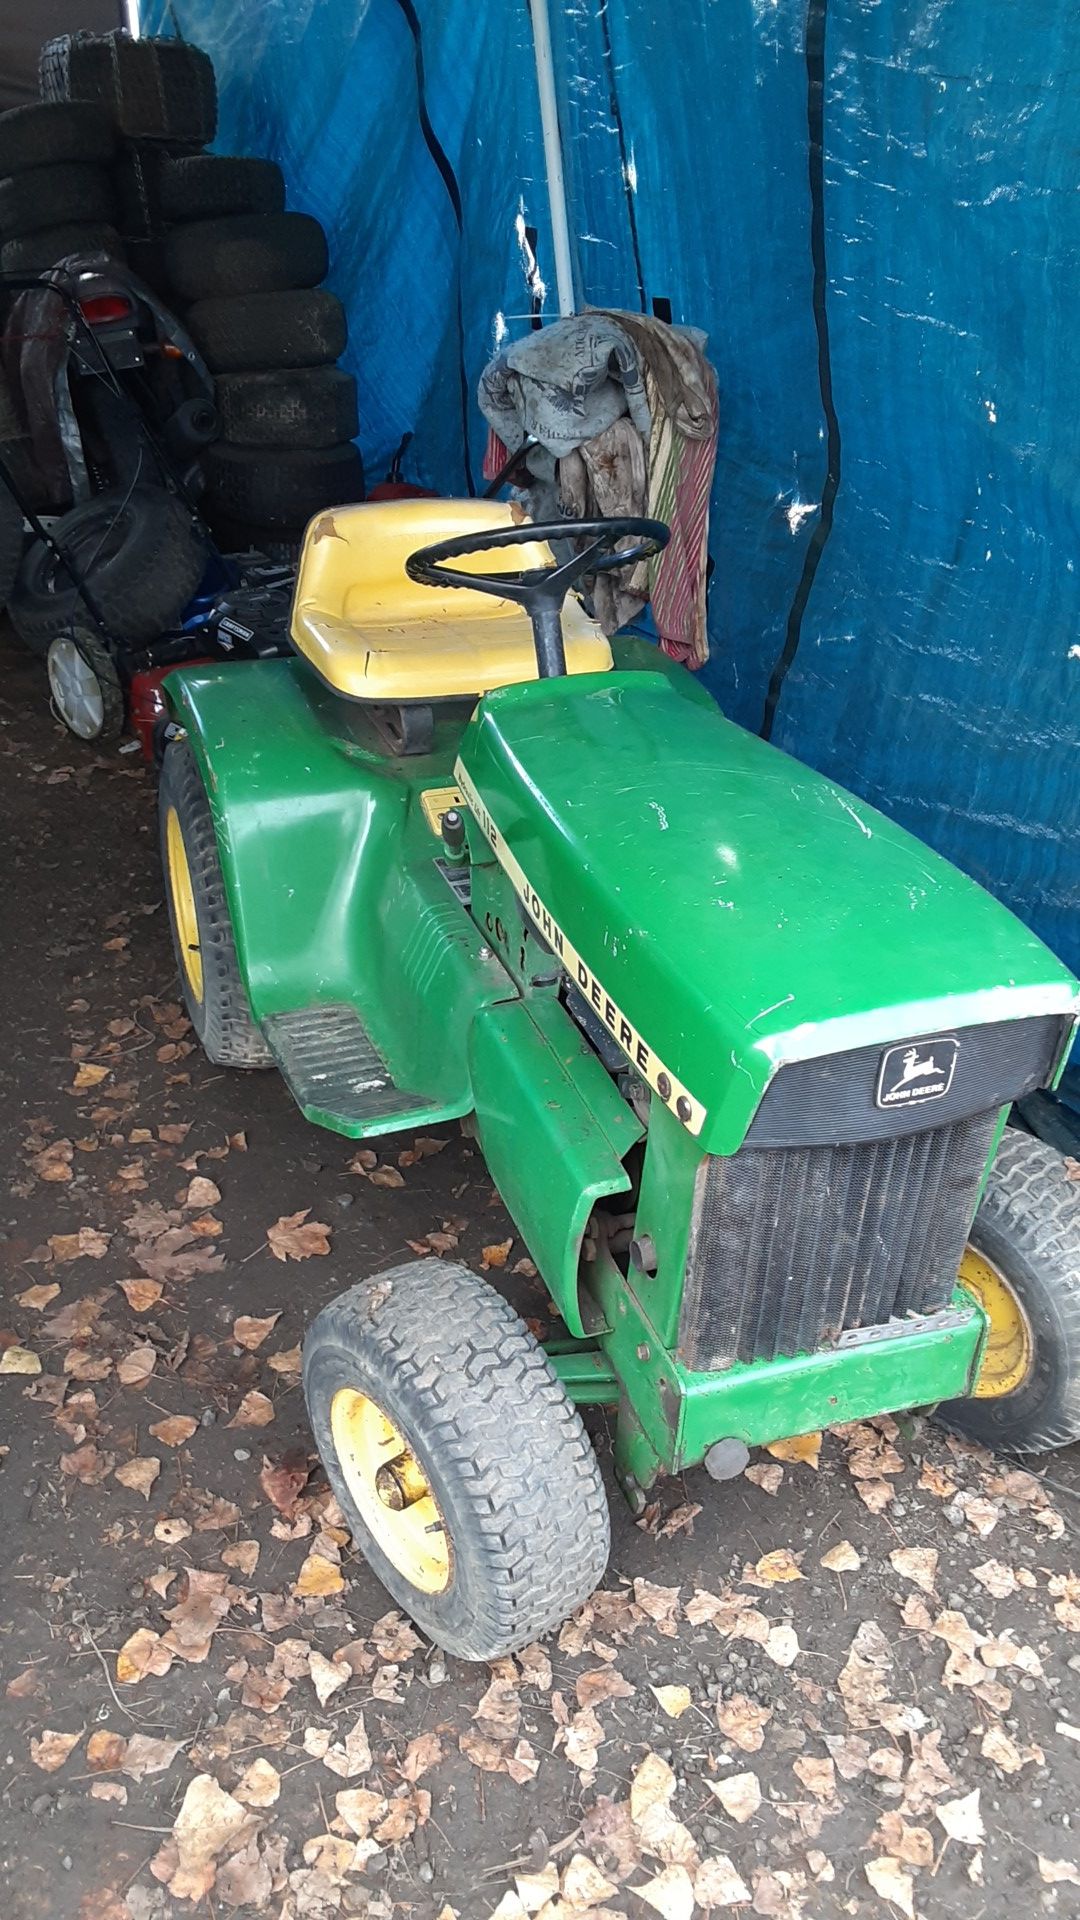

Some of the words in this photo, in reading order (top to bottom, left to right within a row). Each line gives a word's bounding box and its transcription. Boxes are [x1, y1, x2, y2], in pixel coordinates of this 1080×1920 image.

[482, 810, 497, 849] 112
[522, 882, 565, 957] JOHN
[577, 959, 650, 1075] DEERE
[882, 1089, 911, 1102] JOHN
[911, 1082, 945, 1096] DEERE
